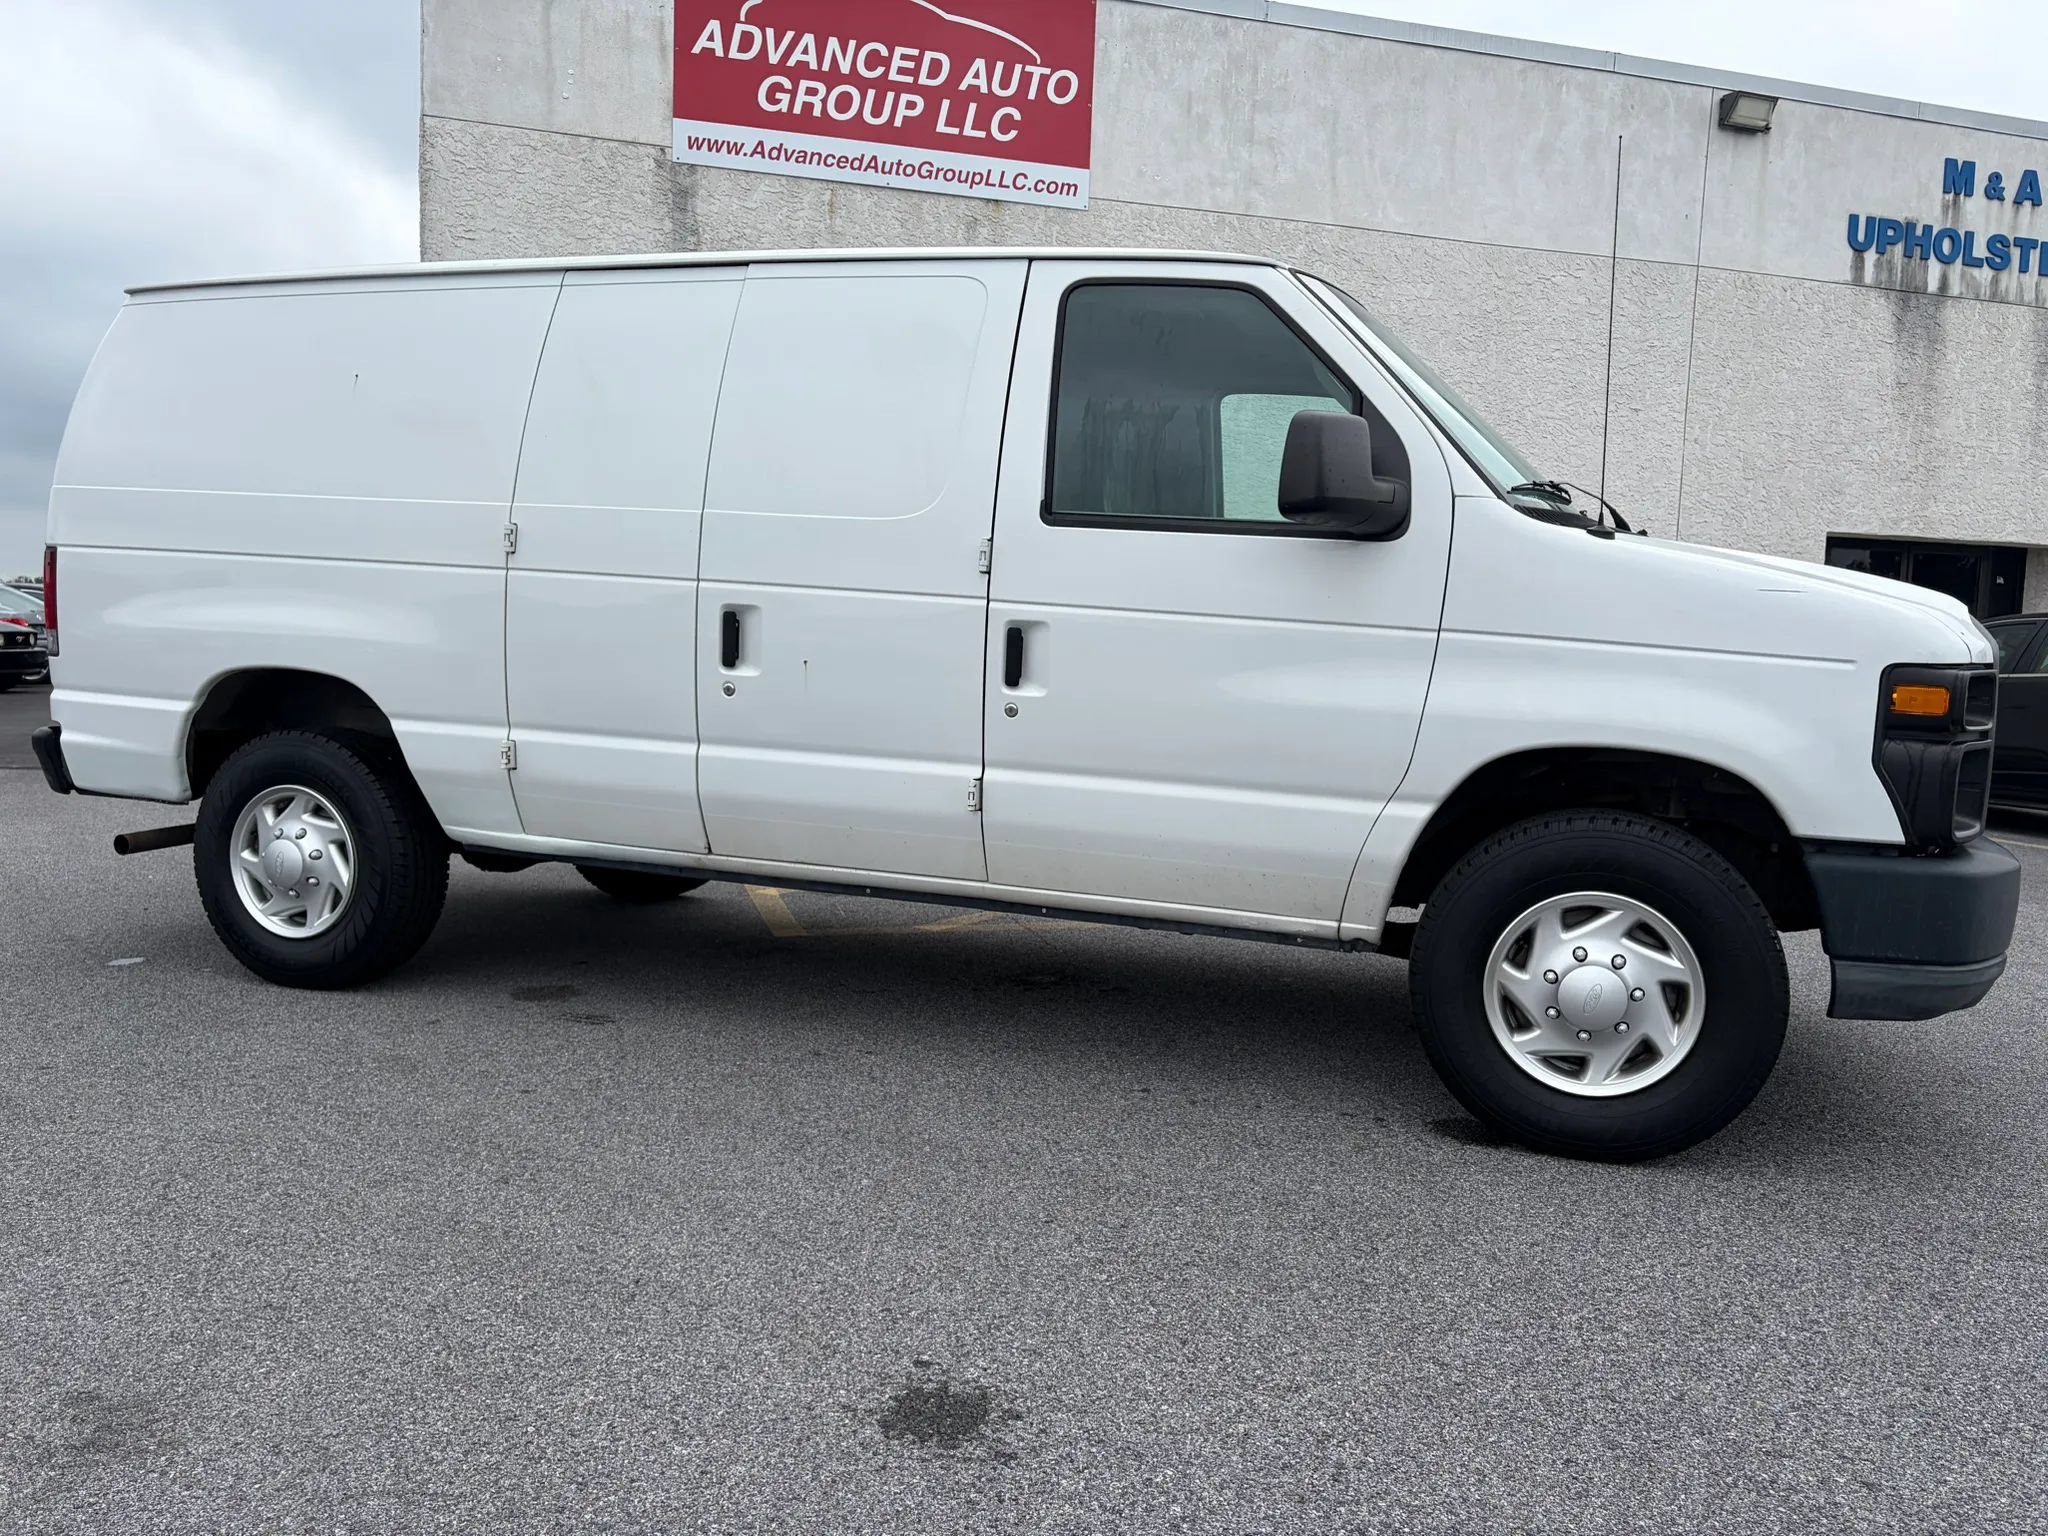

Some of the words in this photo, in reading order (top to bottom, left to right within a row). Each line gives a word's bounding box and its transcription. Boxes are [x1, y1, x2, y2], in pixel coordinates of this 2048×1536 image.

[691, 19, 951, 87] ADVANCED
[958, 57, 1079, 105] AUTO
[757, 75, 925, 128] GROUP
[935, 98, 1022, 142] LLC
[686, 134, 1079, 197] www.AdvancedAutoGroupLLC.com
[1942, 157, 1976, 197] M
[1984, 171, 2005, 201] &
[2013, 169, 2043, 206] A
